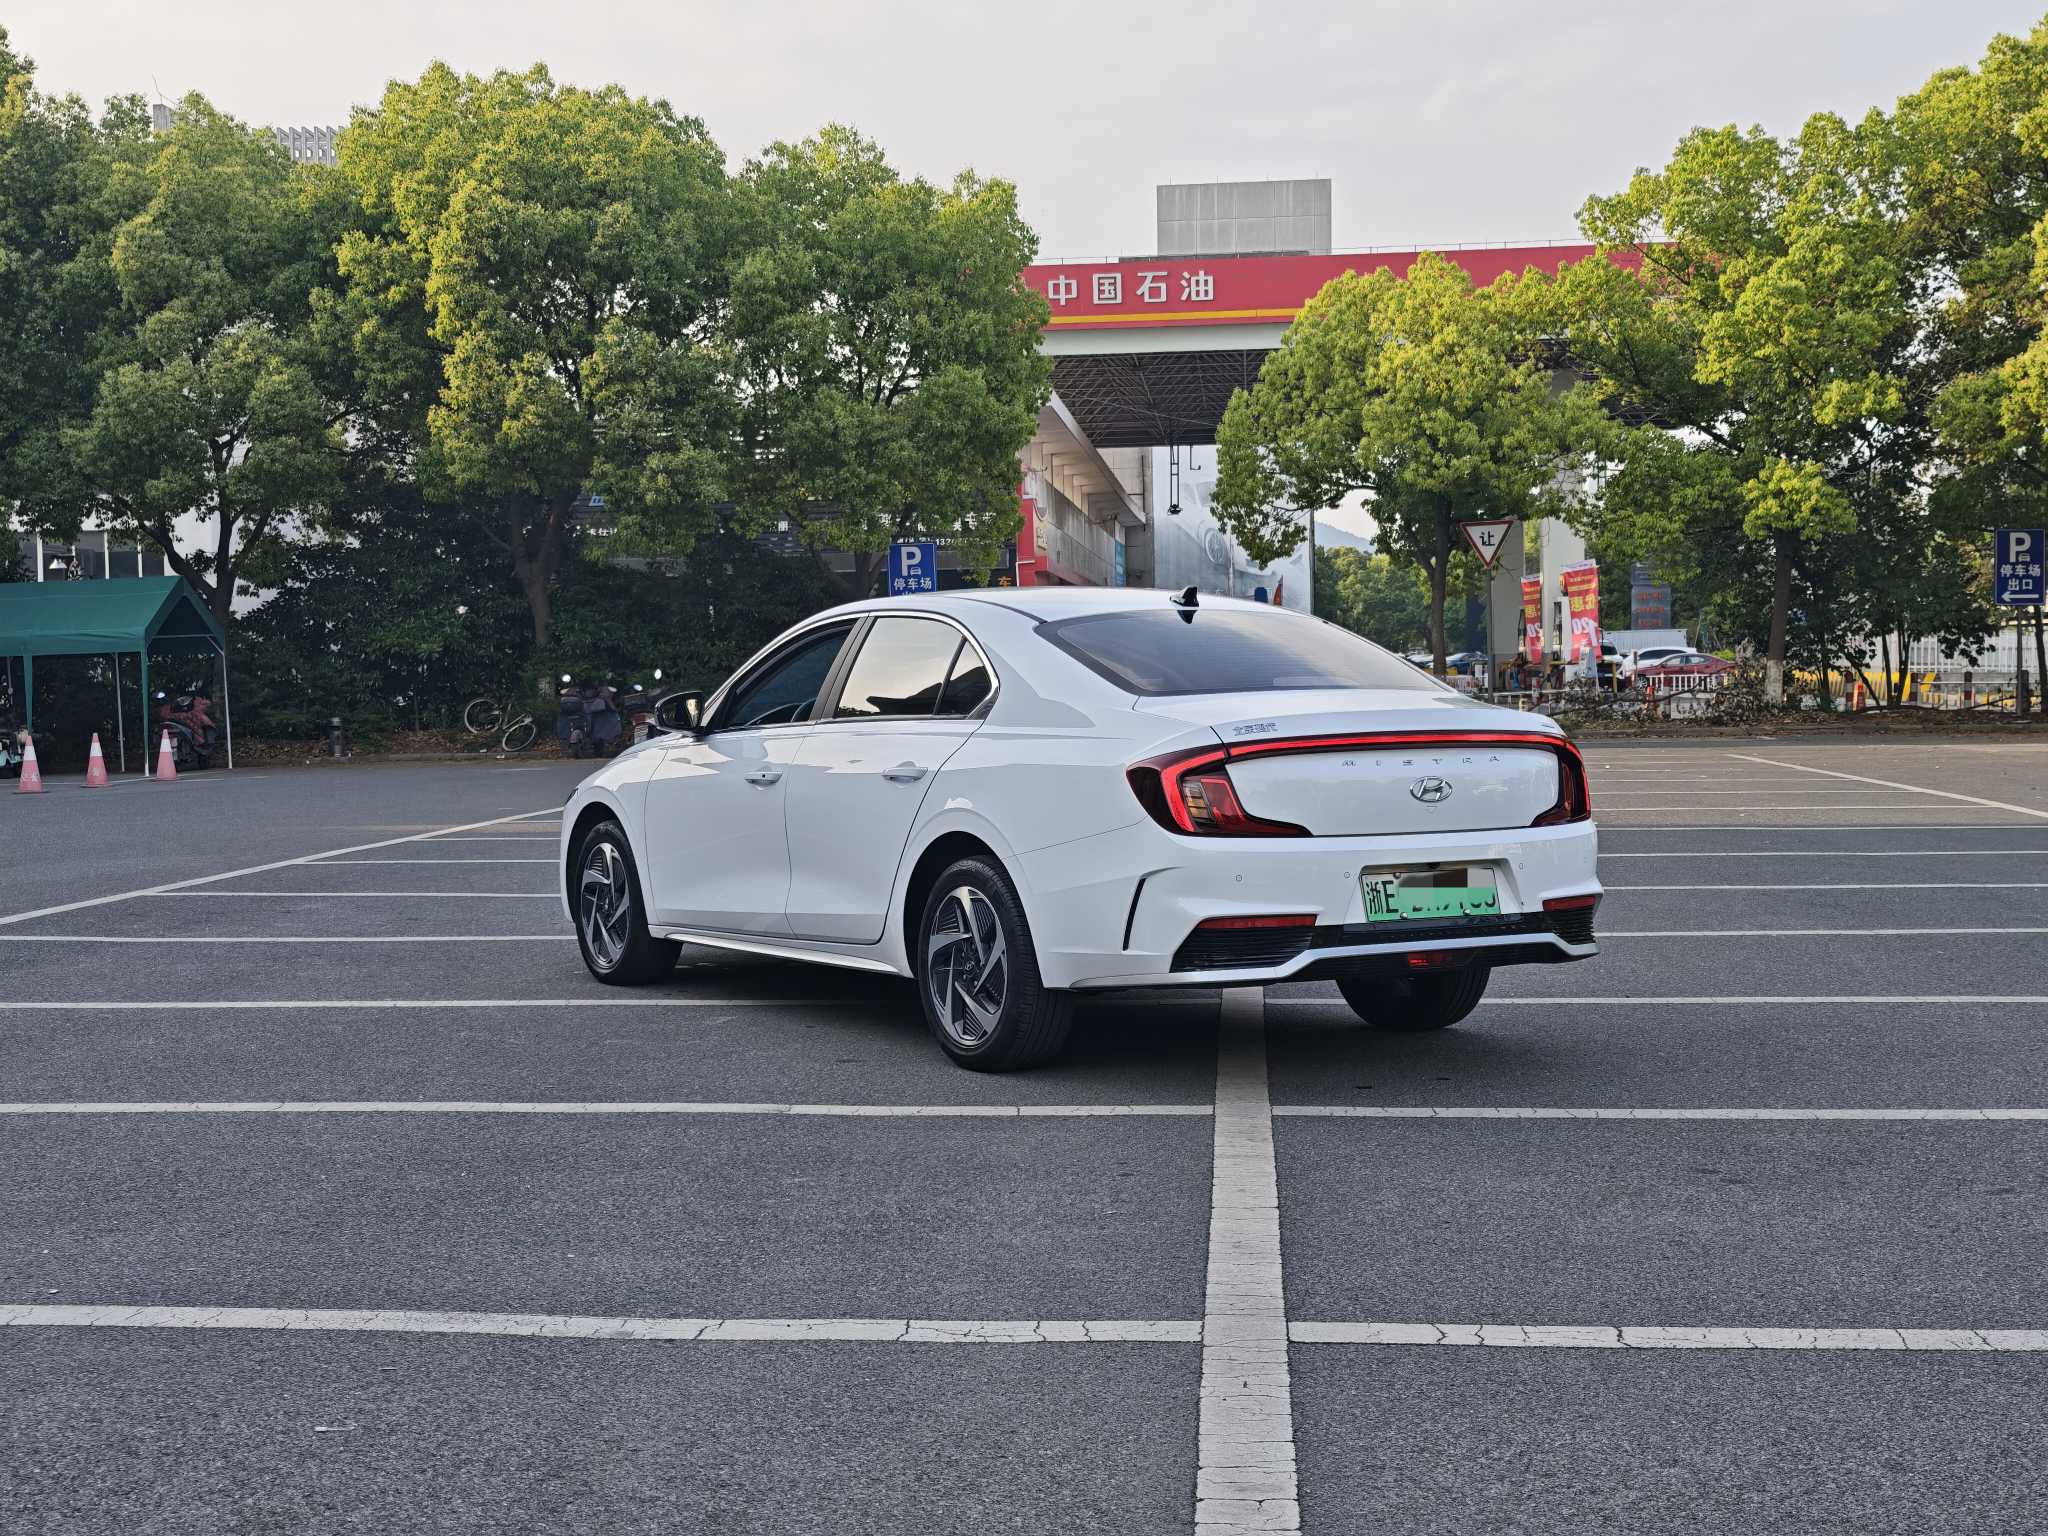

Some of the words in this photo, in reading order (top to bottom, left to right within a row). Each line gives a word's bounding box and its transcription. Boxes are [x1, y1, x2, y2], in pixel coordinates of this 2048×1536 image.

[1047, 270, 1214, 306] 中国石油
[1479, 530, 1495, 547] 让
[2009, 532, 2031, 563] P
[901, 546, 921, 577] P
[2000, 563, 2041, 578] 停车场
[893, 576, 932, 591] 停车场
[2007, 578, 2033, 591] 出口
[1341, 752, 1501, 767] MISTRA
